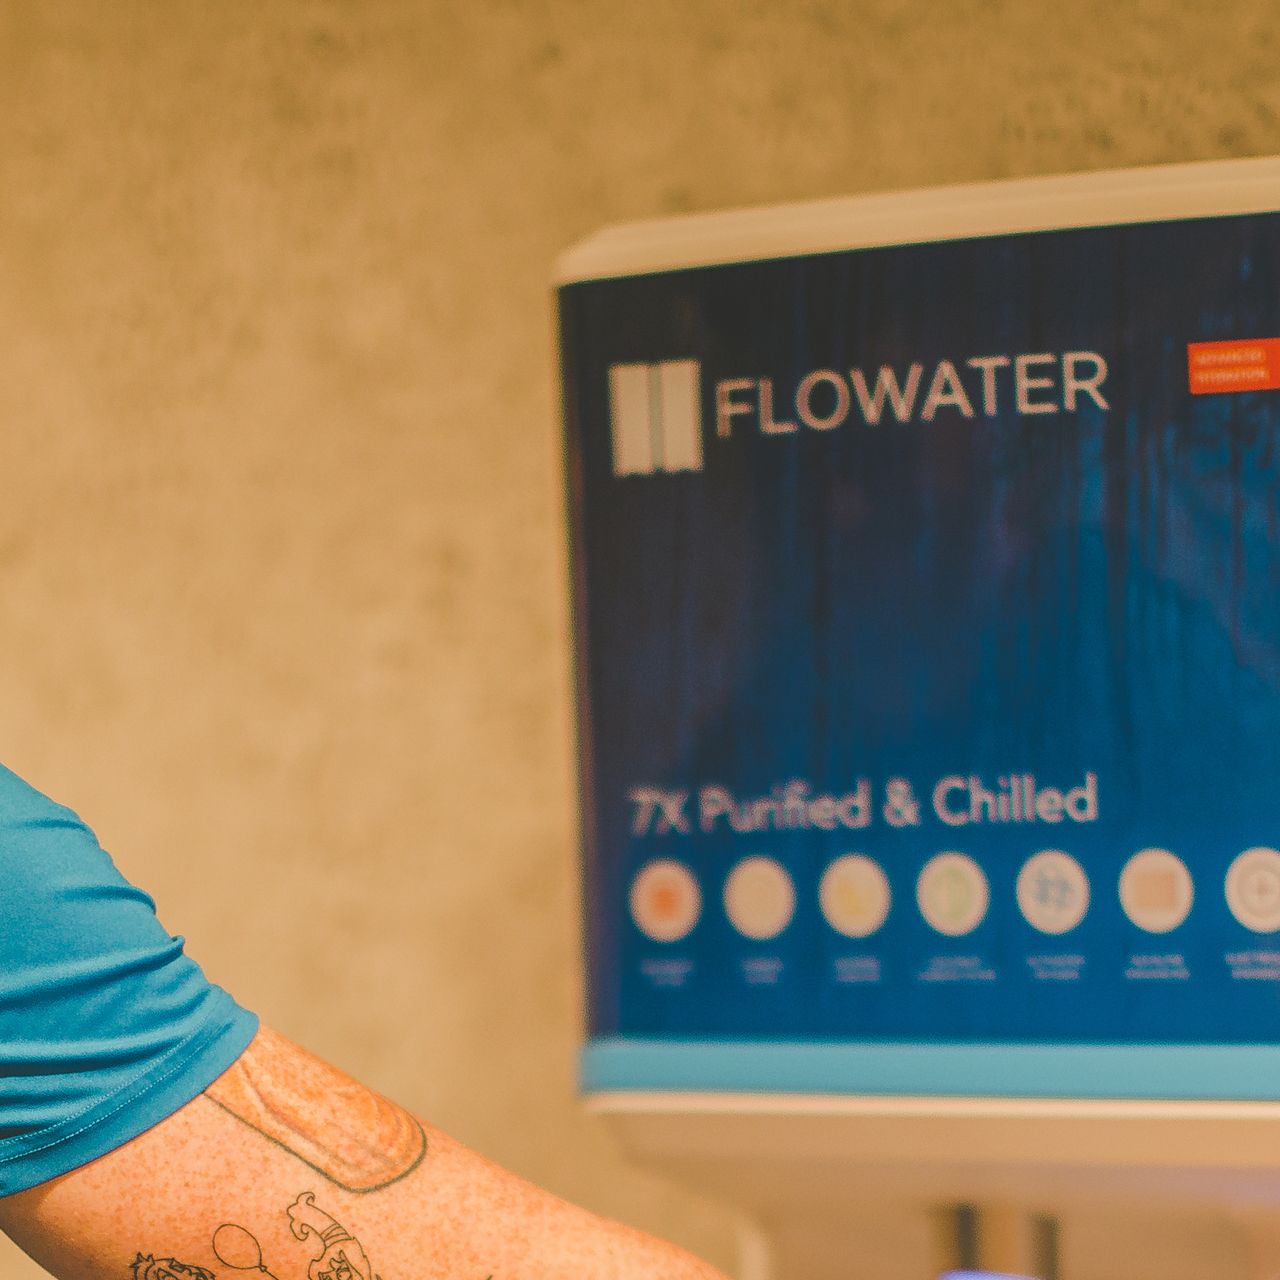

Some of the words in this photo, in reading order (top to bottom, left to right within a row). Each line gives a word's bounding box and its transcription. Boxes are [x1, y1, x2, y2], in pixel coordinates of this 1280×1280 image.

[716, 351, 1111, 437] FLOWATER
[630, 787, 690, 834] 7X
[699, 780, 873, 833] Purified
[884, 778, 921, 828] &
[932, 772, 1099, 828] Chilled
